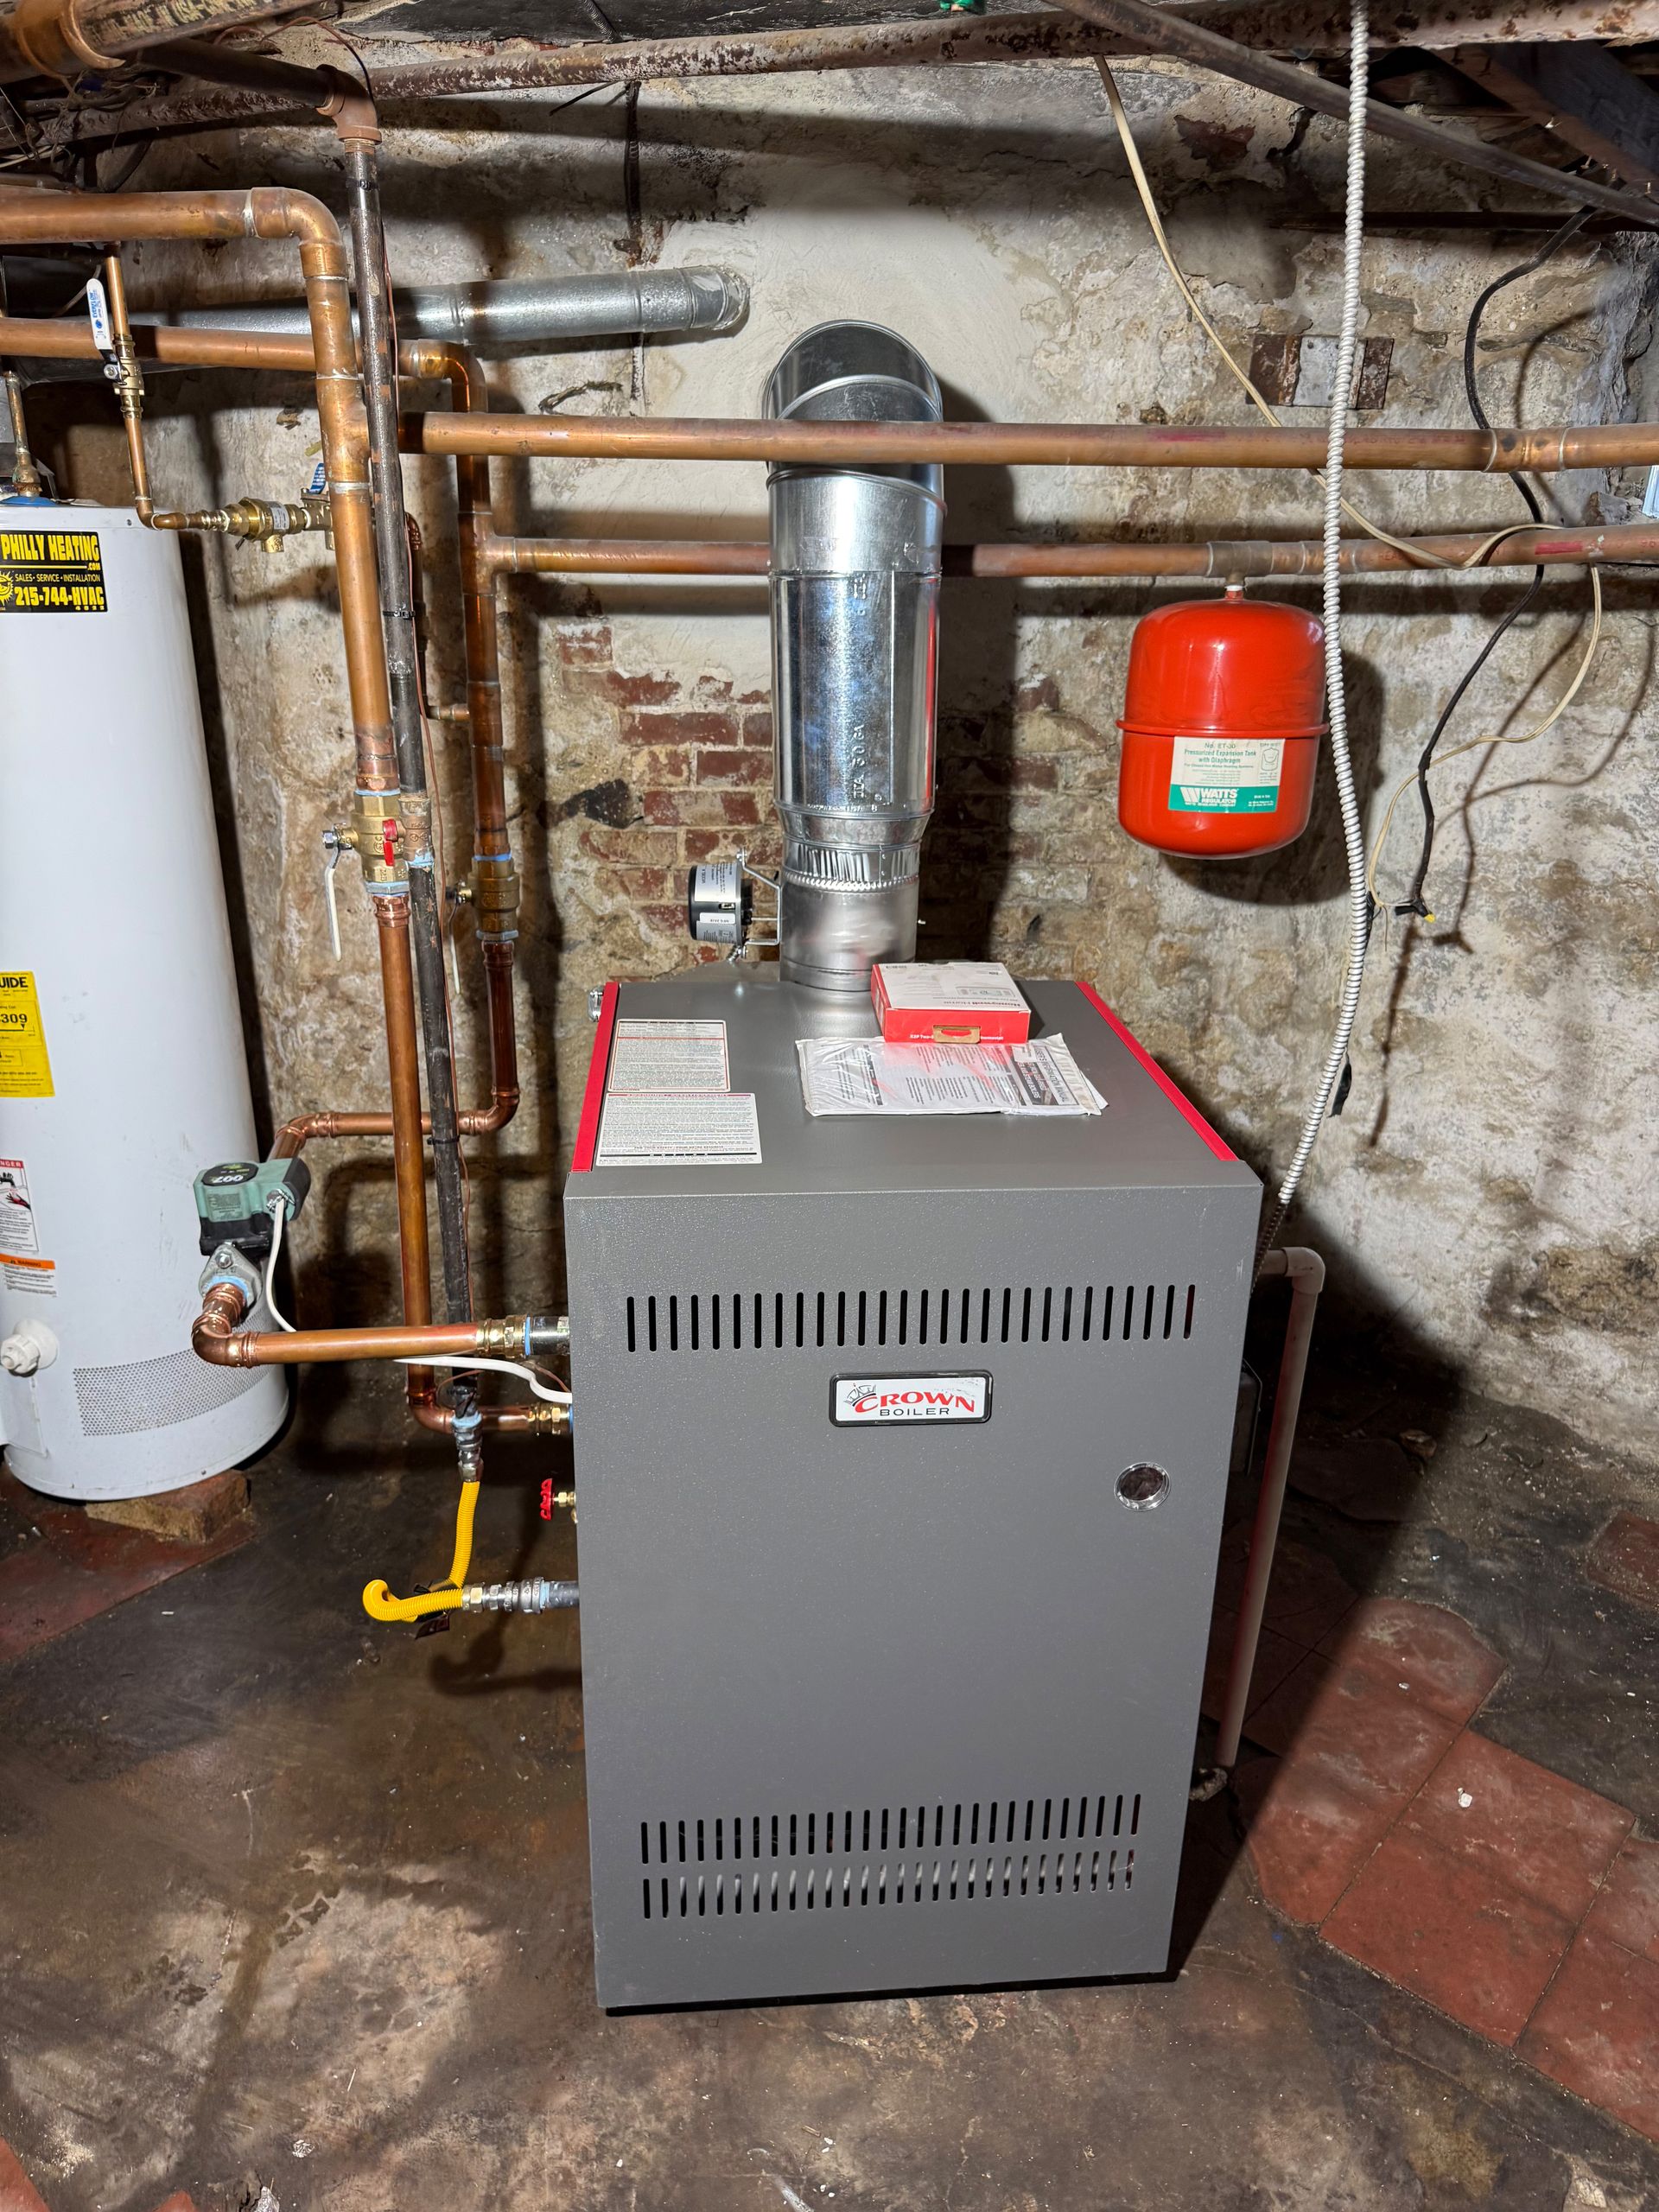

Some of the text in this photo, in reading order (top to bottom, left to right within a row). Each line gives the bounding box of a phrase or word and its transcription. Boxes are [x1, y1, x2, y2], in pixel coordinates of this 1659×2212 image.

[1, 535, 100, 562] PHILLY HEATING
[87, 563, 101, 571] .COM
[15, 574, 101, 582] SALES SERVICE INSTALLATION
[14, 587, 105, 606] 215-744-HVAC
[1201, 788, 1238, 798] WATTS
[855, 1391, 976, 1414] CROWN
[880, 1408, 950, 1417] BOILER
